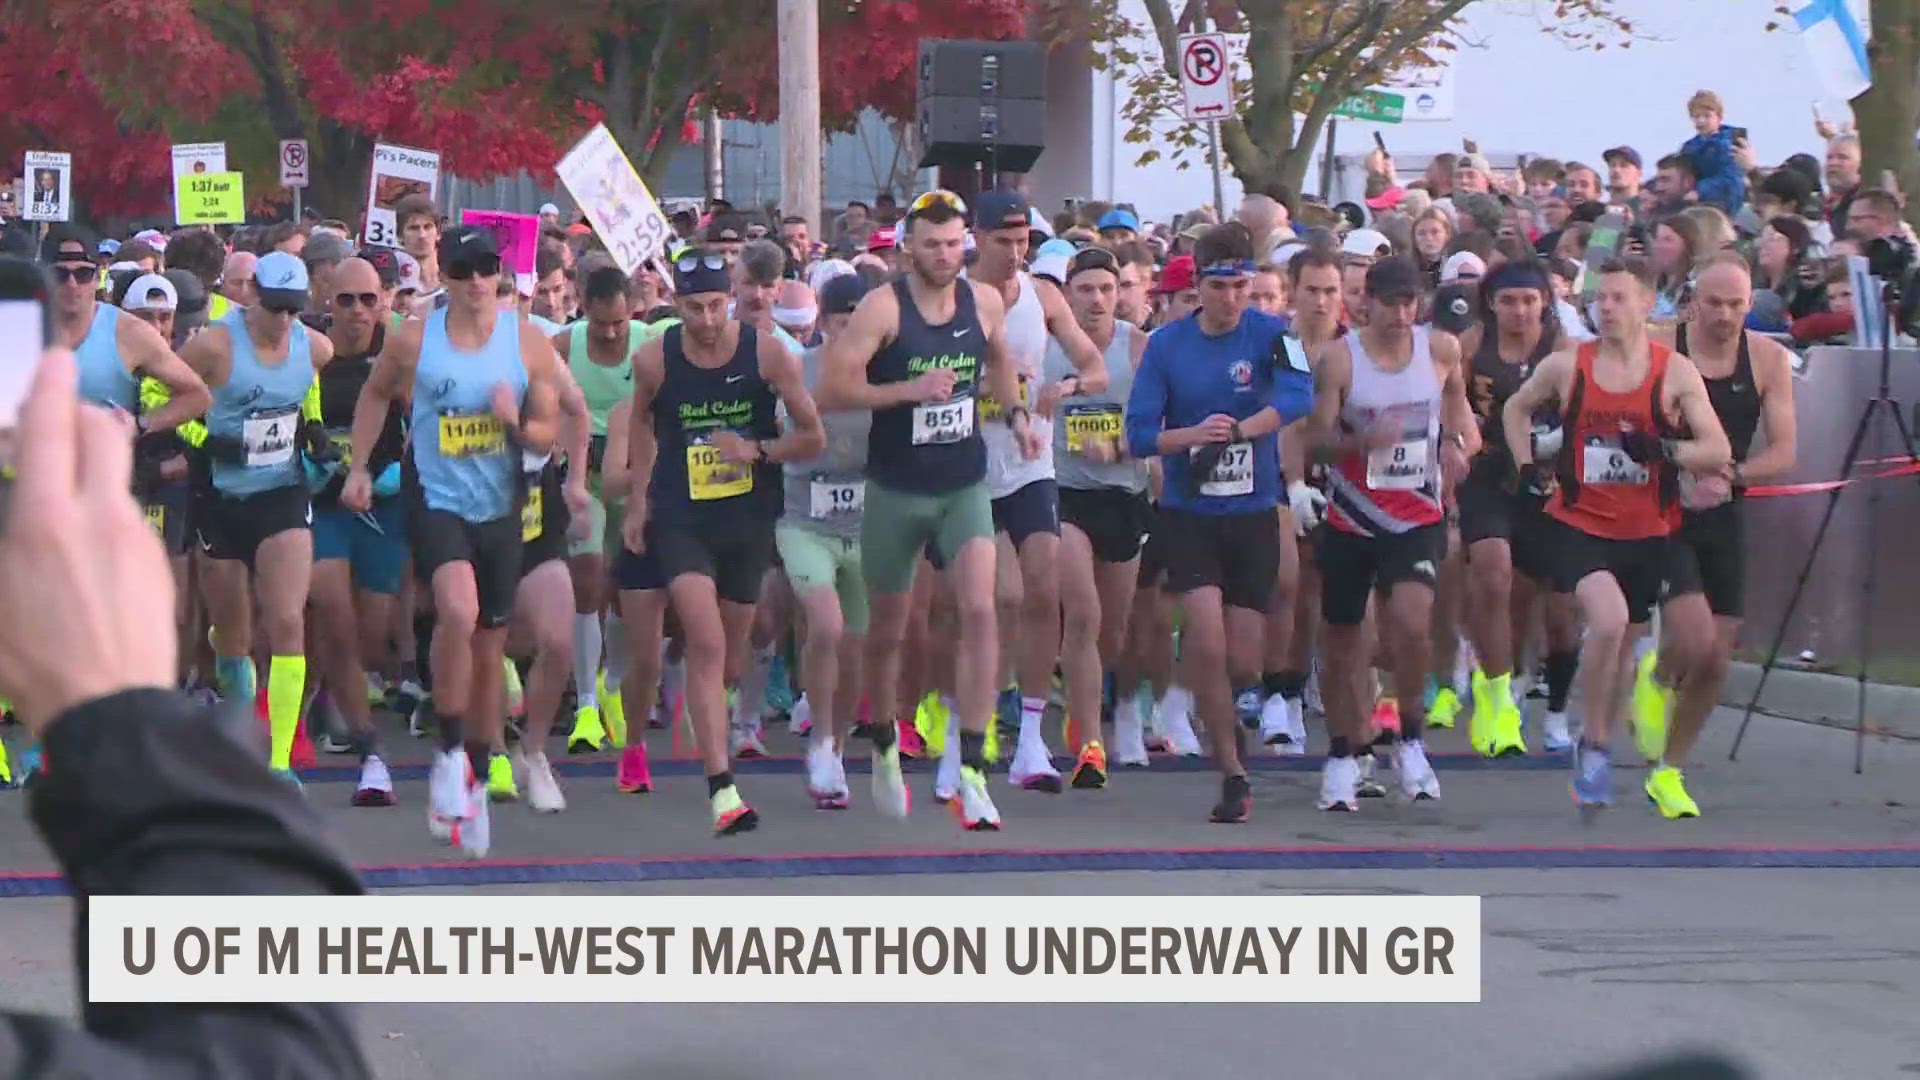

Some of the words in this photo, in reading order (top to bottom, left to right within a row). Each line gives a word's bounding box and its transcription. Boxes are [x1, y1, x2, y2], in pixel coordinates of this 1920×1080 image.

[398, 153, 438, 169] Pacers
[191, 179, 212, 192] 1:37
[31, 203, 60, 214] 8:32
[368, 221, 394, 245] 3:
[616, 212, 663, 265] 2:59
[907, 355, 937, 370] Red
[939, 351, 977, 369] Cedar
[679, 402, 708, 417] Red
[711, 400, 752, 415] Cedar
[925, 407, 963, 428] 851
[265, 422, 279, 437] 4
[1393, 447, 1406, 462] 8
[1608, 453, 1624, 468] 6
[829, 488, 855, 503] 10
